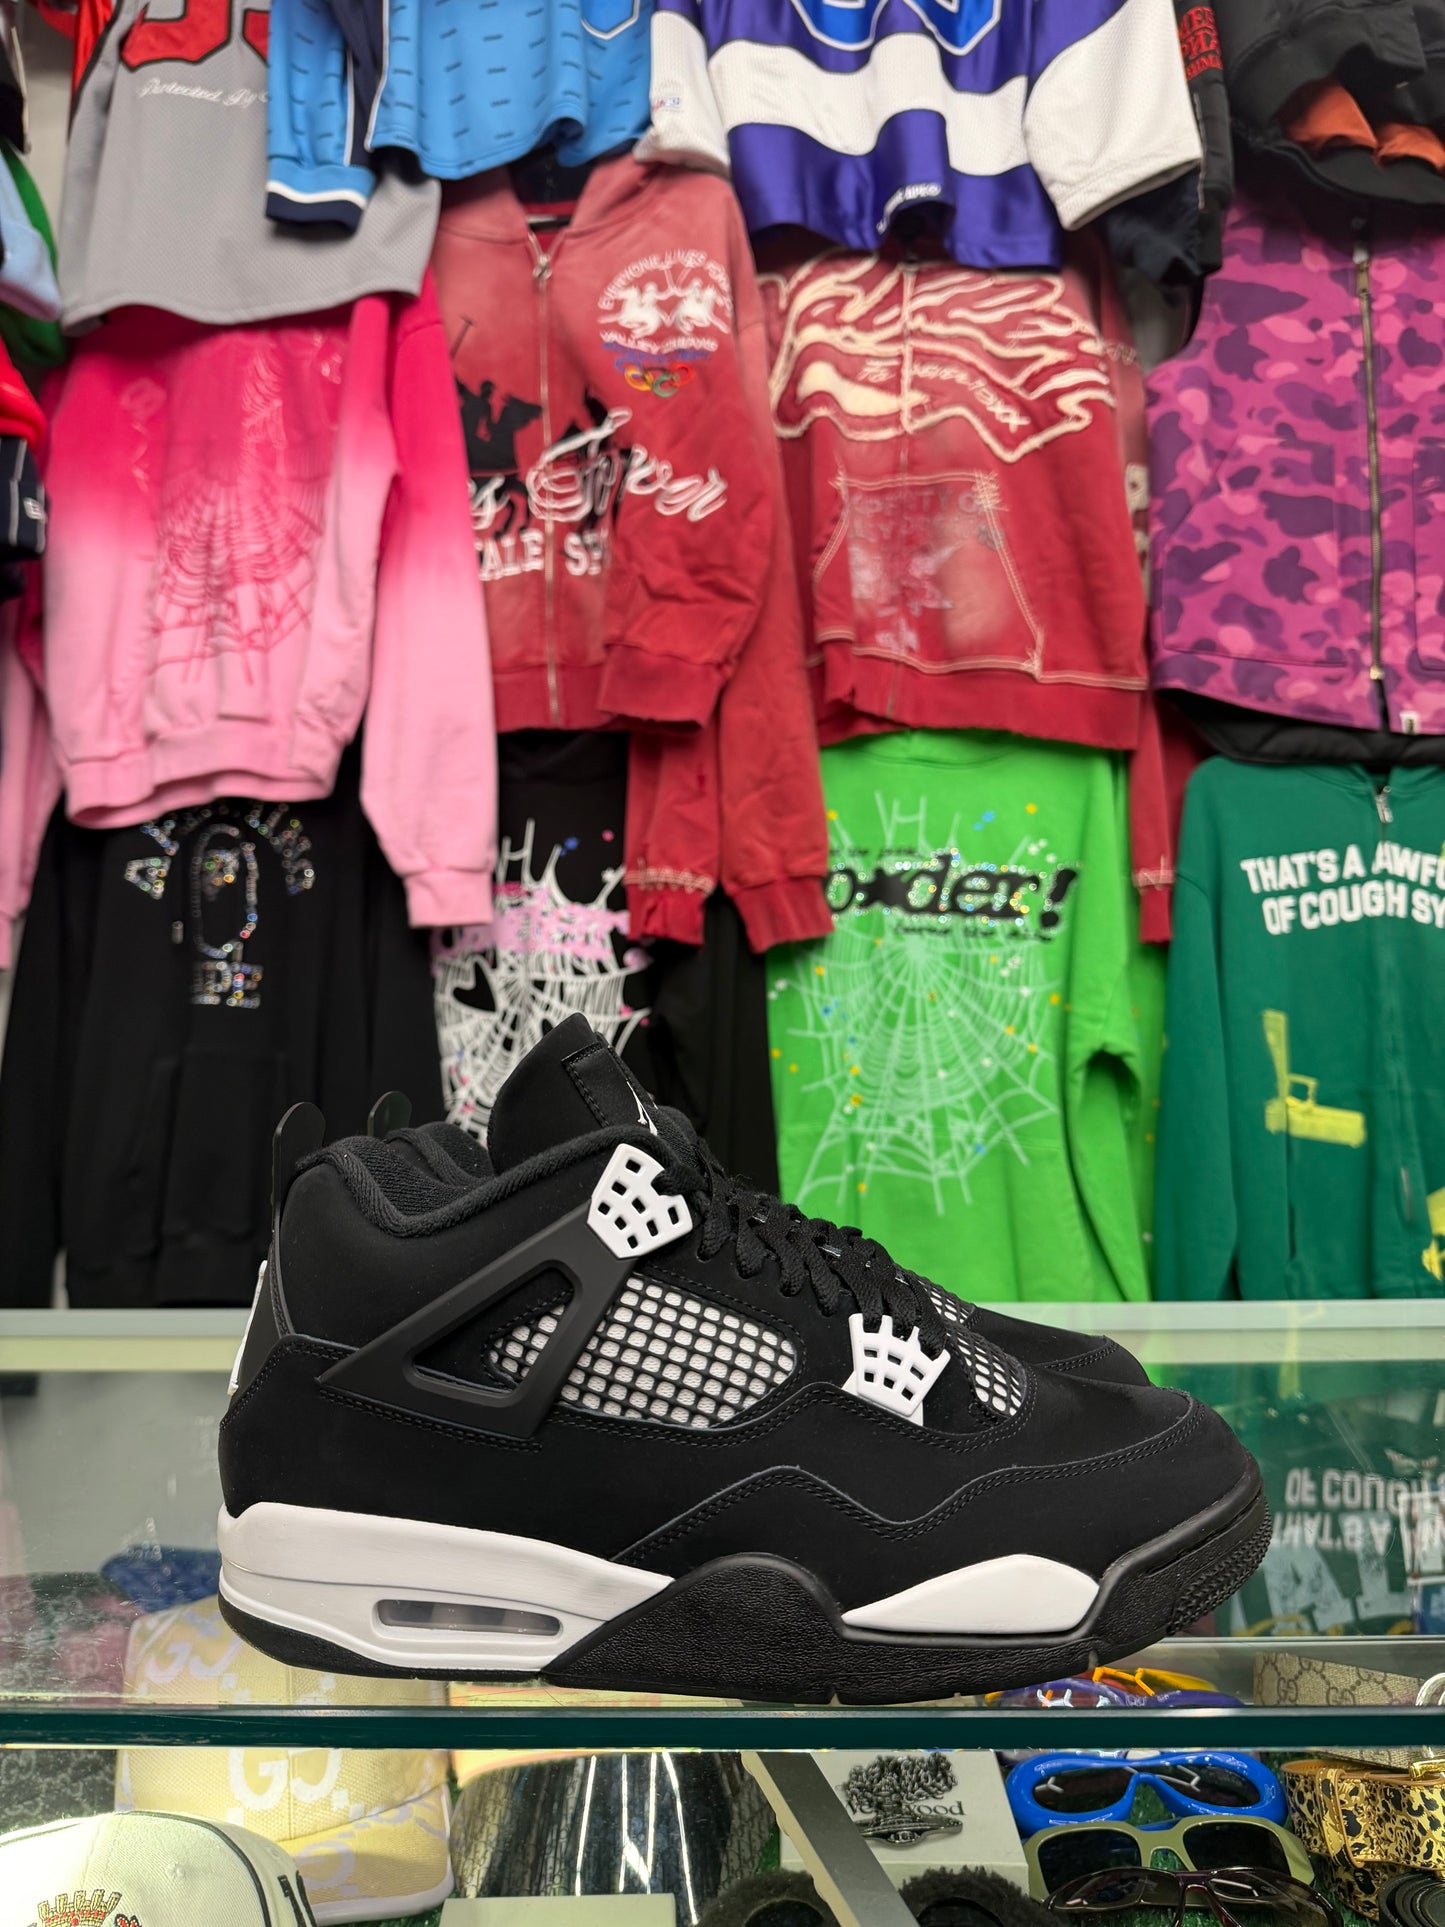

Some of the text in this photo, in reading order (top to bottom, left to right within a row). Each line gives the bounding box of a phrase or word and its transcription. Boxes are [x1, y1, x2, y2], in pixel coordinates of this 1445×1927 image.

[1240, 848, 1340, 893] THAT'S
[1342, 844, 1366, 880] A
[1262, 896, 1296, 935] OF
[1300, 879, 1409, 930] COUGH
